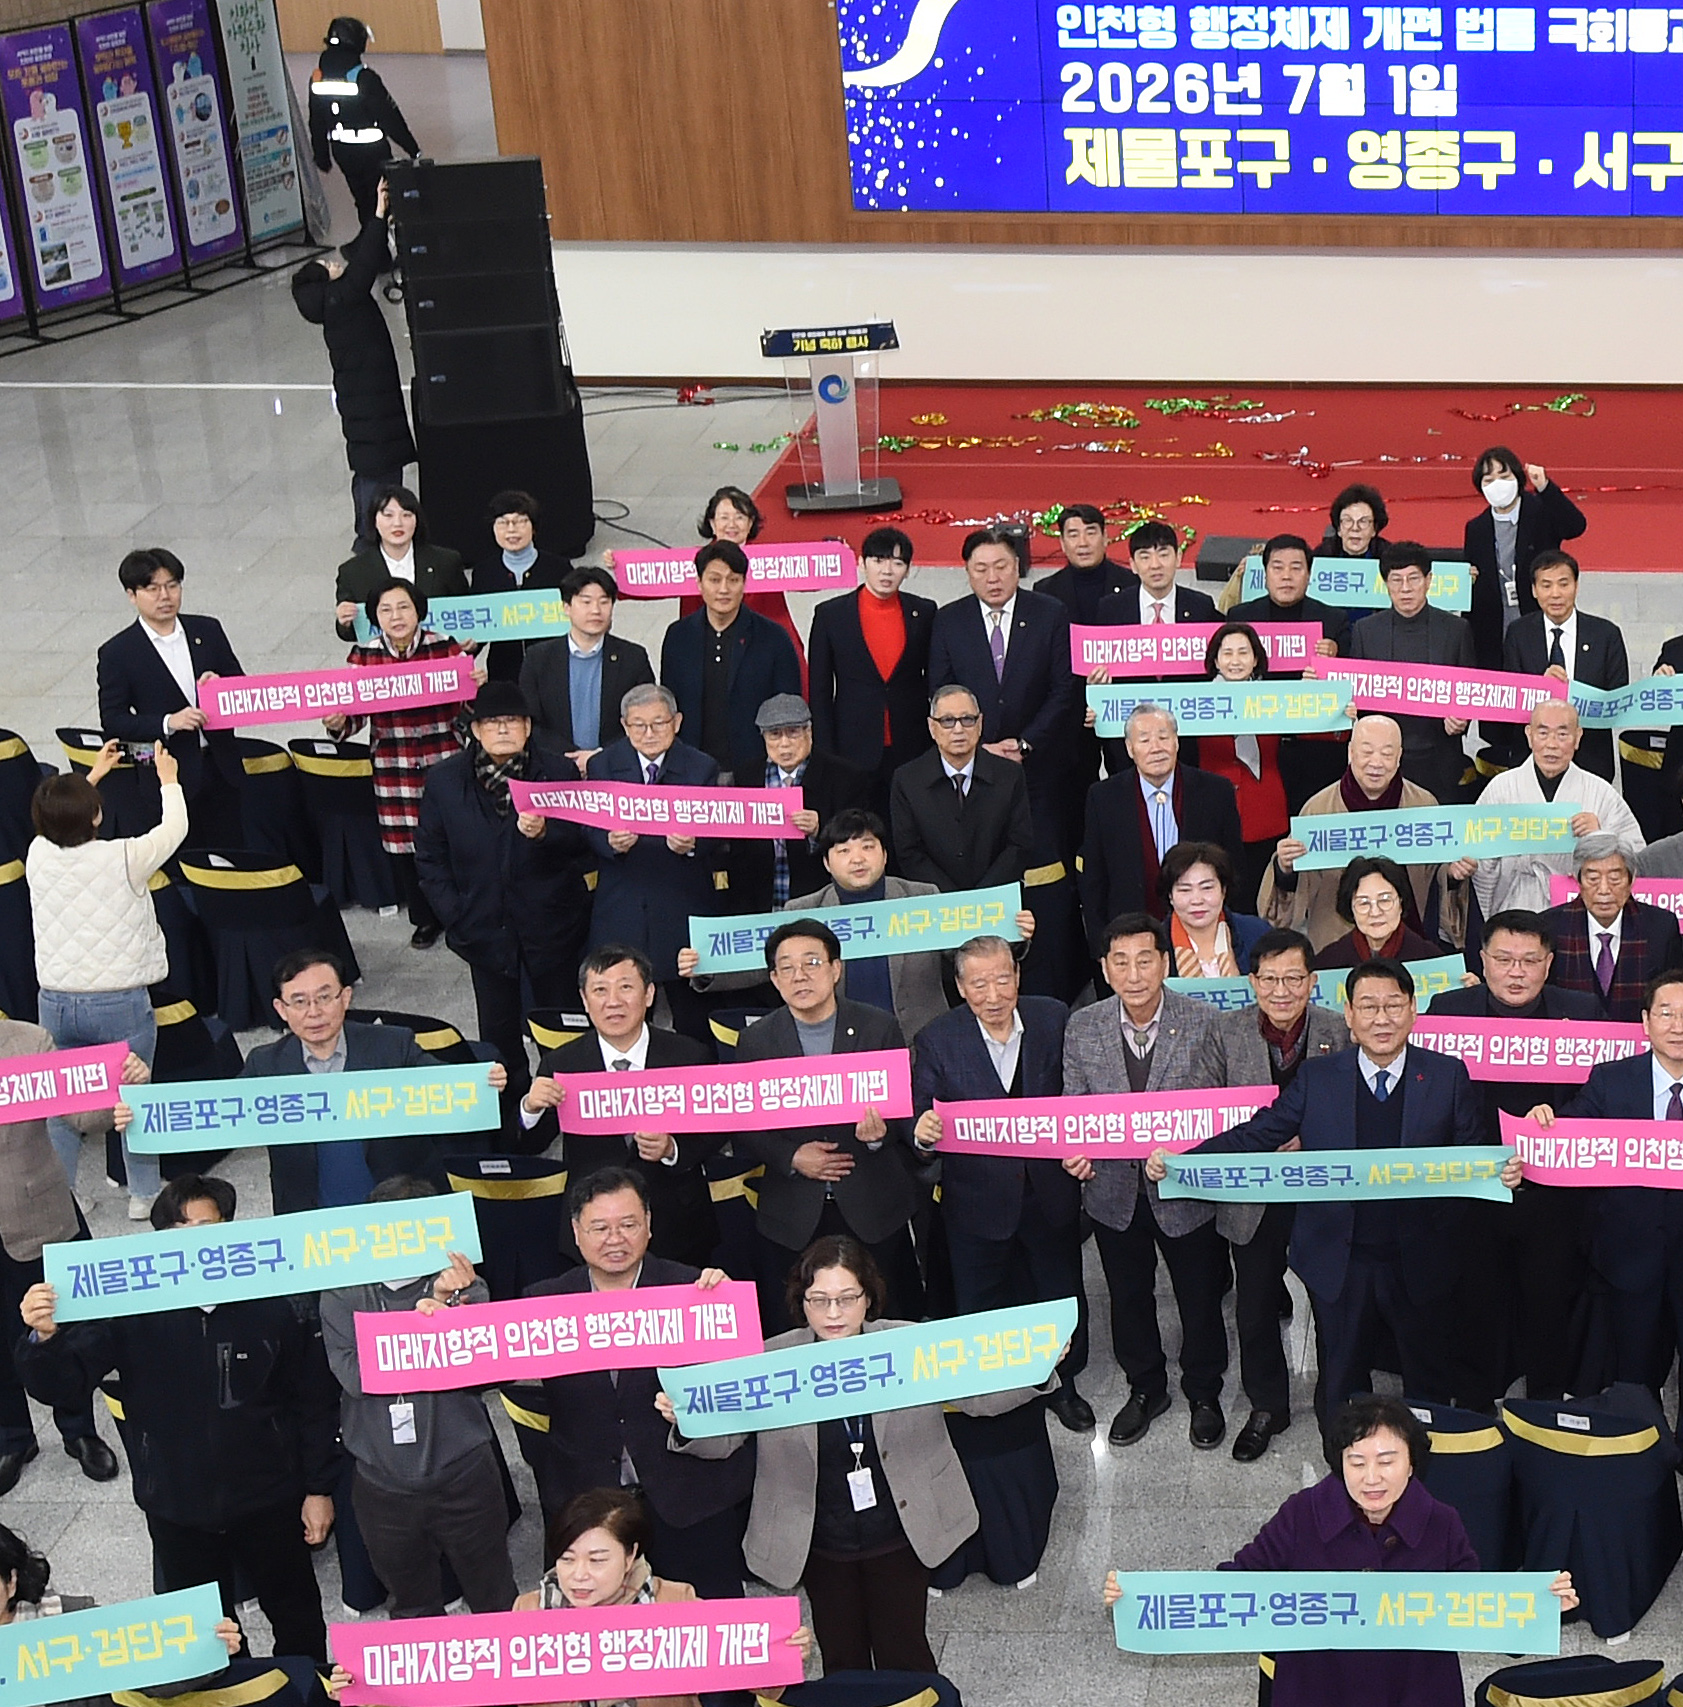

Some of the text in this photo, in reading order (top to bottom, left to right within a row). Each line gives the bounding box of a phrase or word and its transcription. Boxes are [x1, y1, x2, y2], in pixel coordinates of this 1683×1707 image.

[1056, 4, 1177, 49] 인천형
[1189, 6, 1350, 51] 행정체제
[1362, 7, 1442, 51] 개편
[1060, 61, 1458, 117] 2026년 7월 1일
[1063, 127, 1291, 189] 제물포구
[1347, 130, 1516, 191] 영종구
[749, 556, 808, 579] 행정체제
[811, 555, 841, 577] 개편
[1083, 638, 1157, 664] 미래지향적
[1162, 637, 1206, 661] 인천형
[1275, 635, 1305, 657] 개편
[218, 670, 458, 715] 미래지향적 인천형 행정체제 개편
[1243, 692, 1340, 720] 서구·검단구
[1407, 678, 1451, 704] 인천형
[1456, 681, 1516, 709] 행정체제
[530, 791, 784, 824] 미래지향적 인천형 행정체제 개편
[1464, 816, 1568, 844] 서구·검단구
[888, 902, 1005, 934] 서구·검단구
[1490, 1036, 1549, 1065] 인천형
[60, 1063, 108, 1095] 개편
[579, 1070, 889, 1118] 미래지향적 인천형 행정체제 개편
[345, 1080, 479, 1121] 서구·검단구
[955, 1116, 1057, 1143] 미래지향적
[1064, 1113, 1125, 1143] 인천형
[1131, 1108, 1213, 1141] 행정체제
[1516, 1135, 1618, 1168] 미래지향적
[1368, 1159, 1497, 1185] 서구·검단구
[302, 1214, 456, 1268] 서구·검단구
[375, 1304, 737, 1371] 미래지향적 인천형 행정체제 개편
[912, 1323, 1060, 1381] 서구·검단구
[1375, 1590, 1539, 1630] 서구·검단구
[17, 1614, 198, 1682] 서구·검단구
[363, 1623, 769, 1685] 미래지향적 인천형 행정체제 개편
